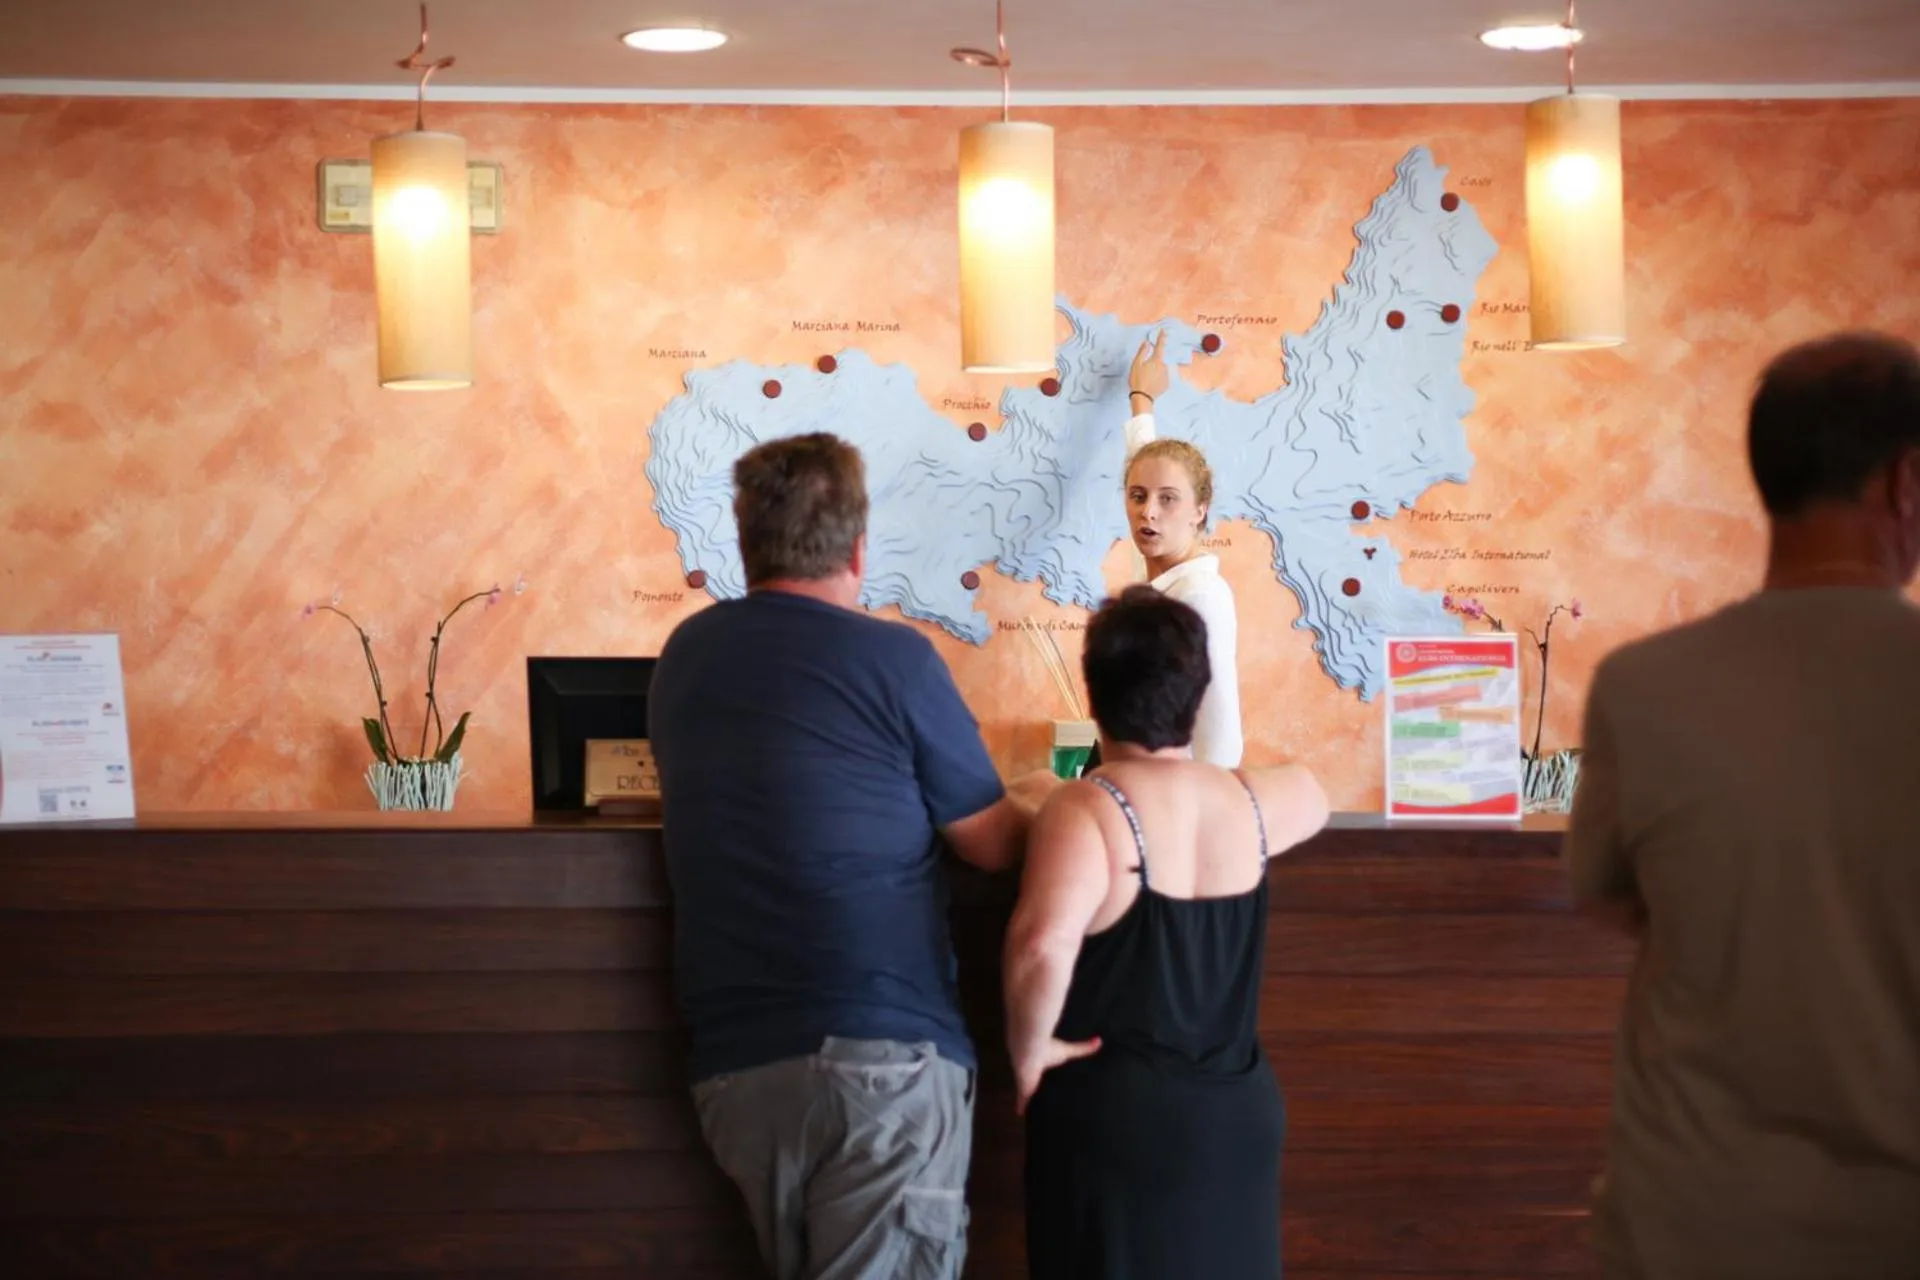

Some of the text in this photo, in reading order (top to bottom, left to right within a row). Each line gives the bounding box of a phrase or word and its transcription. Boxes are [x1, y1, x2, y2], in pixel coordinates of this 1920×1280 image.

[1480, 301, 1531, 316] Rio Mari
[791, 320, 901, 332] Marciana Marina
[648, 348, 707, 359] Marciana
[1471, 340, 1491, 356] Rio
[1409, 509, 1492, 523] Porto Azzurro
[1200, 537, 1232, 549] acona
[1409, 549, 1439, 560] Hotel
[1472, 549, 1552, 560] International
[1446, 583, 1520, 597] Capoliveri
